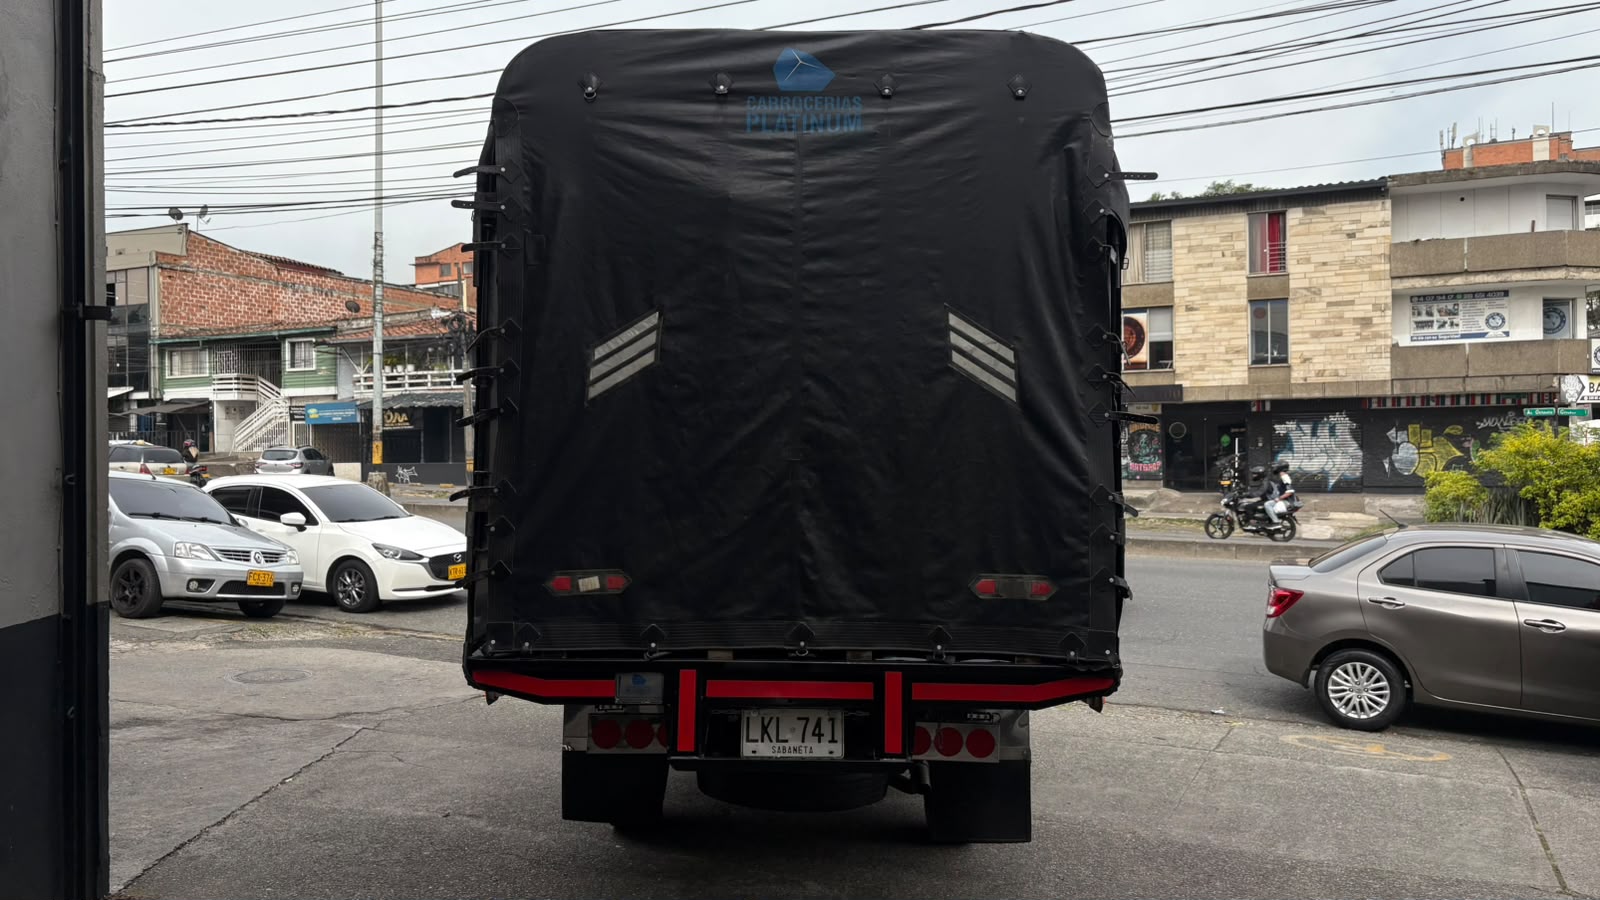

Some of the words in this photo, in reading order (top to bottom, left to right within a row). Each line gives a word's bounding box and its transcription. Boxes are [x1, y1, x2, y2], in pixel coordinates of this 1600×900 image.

[746, 96, 863, 111] CARROCERIAS
[746, 112, 864, 133] PLATINUM
[745, 716, 789, 743] LKL
[796, 716, 838, 744] 741
[771, 745, 814, 754] SABANETA
